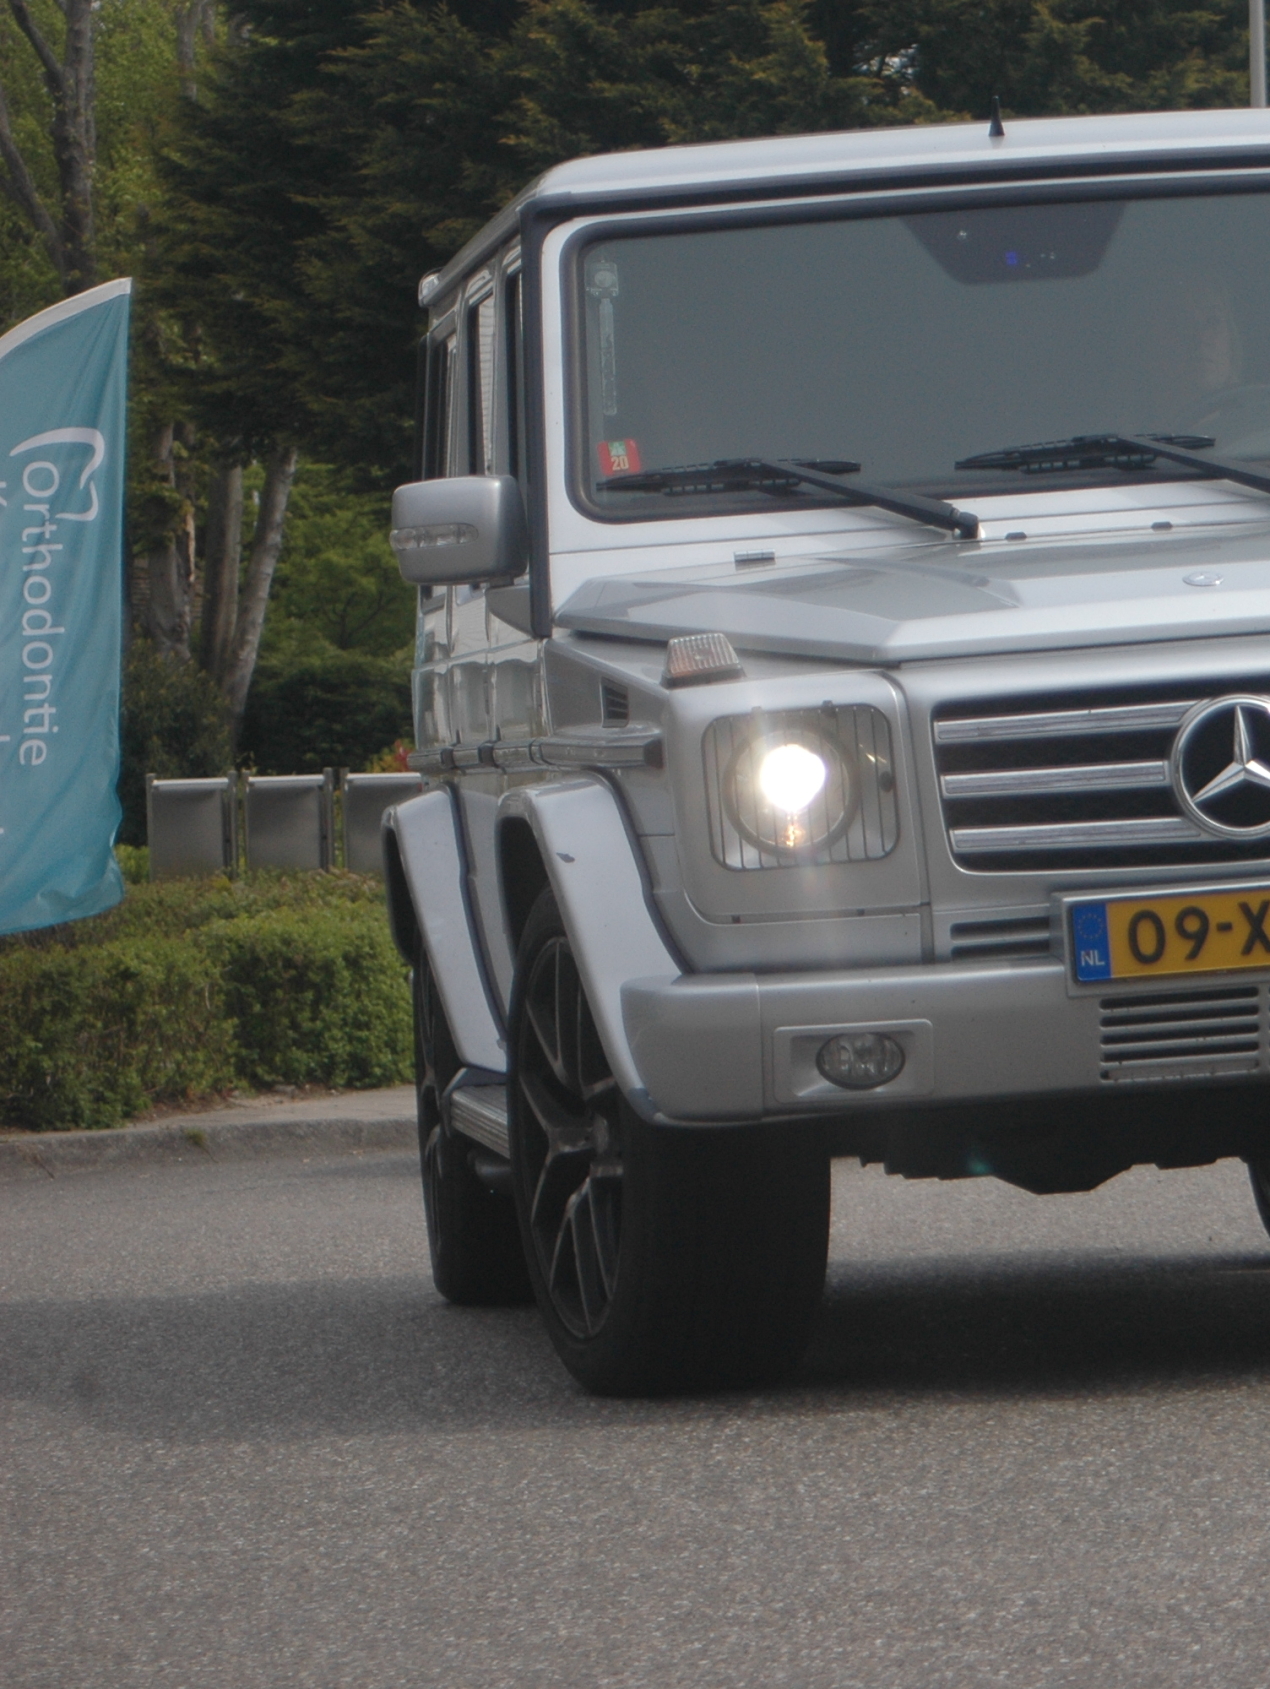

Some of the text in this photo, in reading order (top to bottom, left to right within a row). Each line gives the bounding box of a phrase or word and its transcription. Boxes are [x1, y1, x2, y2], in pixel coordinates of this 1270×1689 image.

[611, 455, 629, 471] 20
[18, 460, 66, 767] Orthodontie
[1080, 949, 1106, 968] NL
